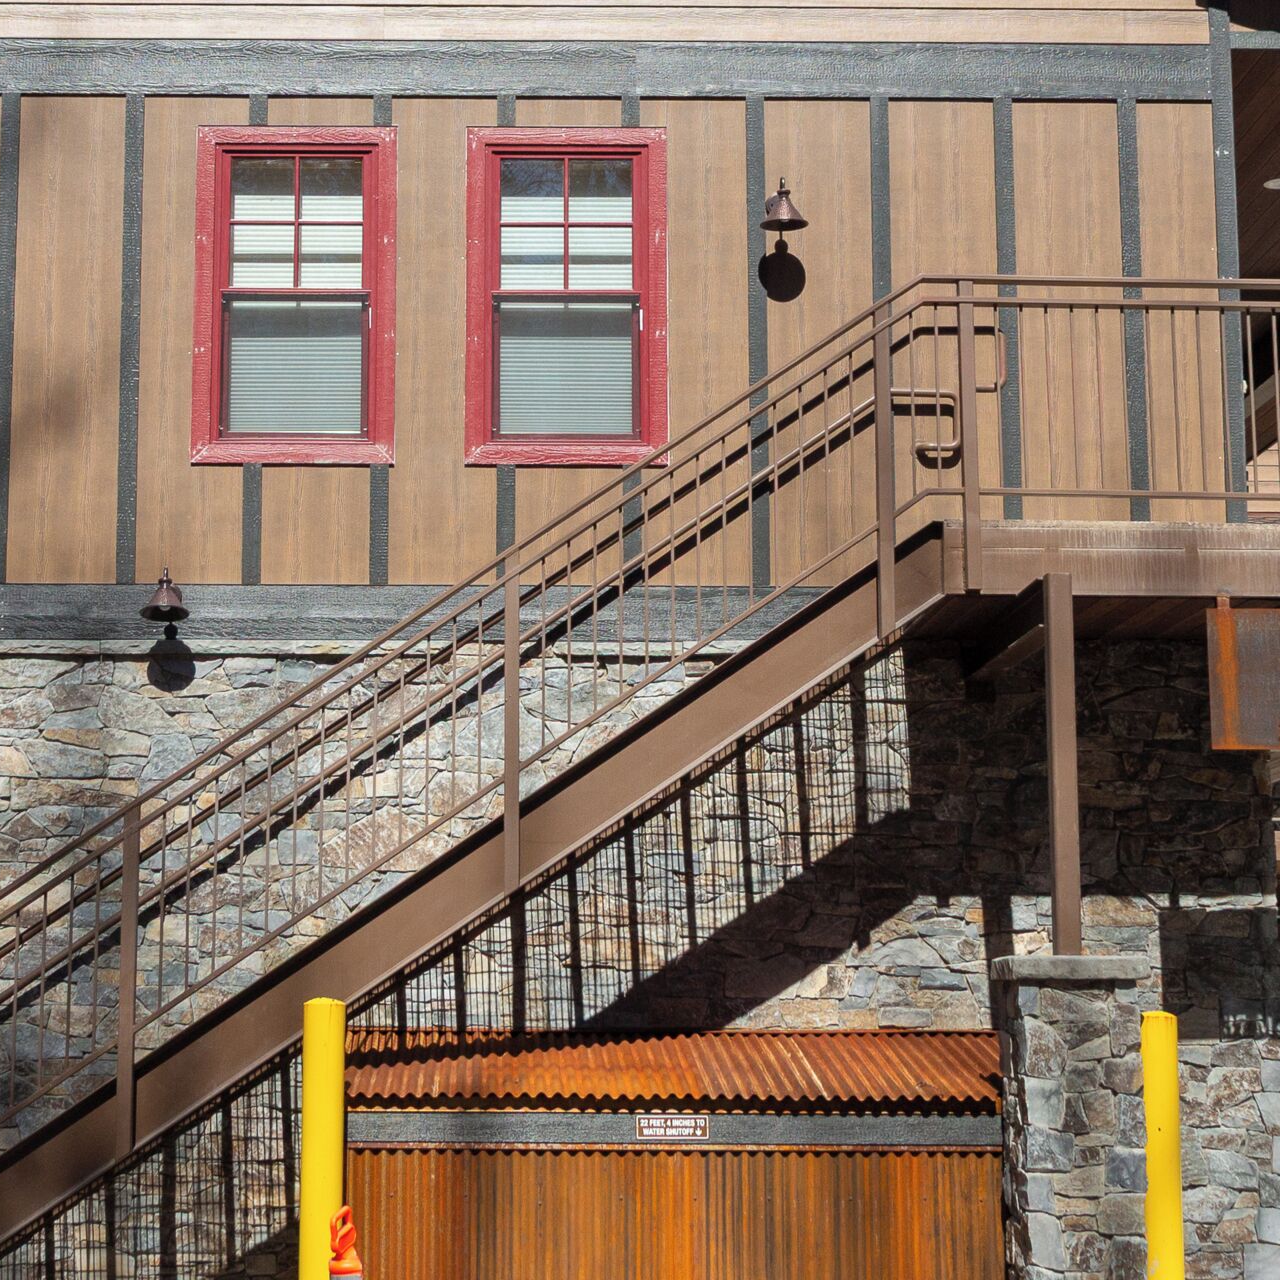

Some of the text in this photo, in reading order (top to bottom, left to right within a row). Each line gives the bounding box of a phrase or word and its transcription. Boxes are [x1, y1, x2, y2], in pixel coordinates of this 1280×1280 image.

[640, 1119, 705, 1128] 22 FEET, 4 INCHES TO
